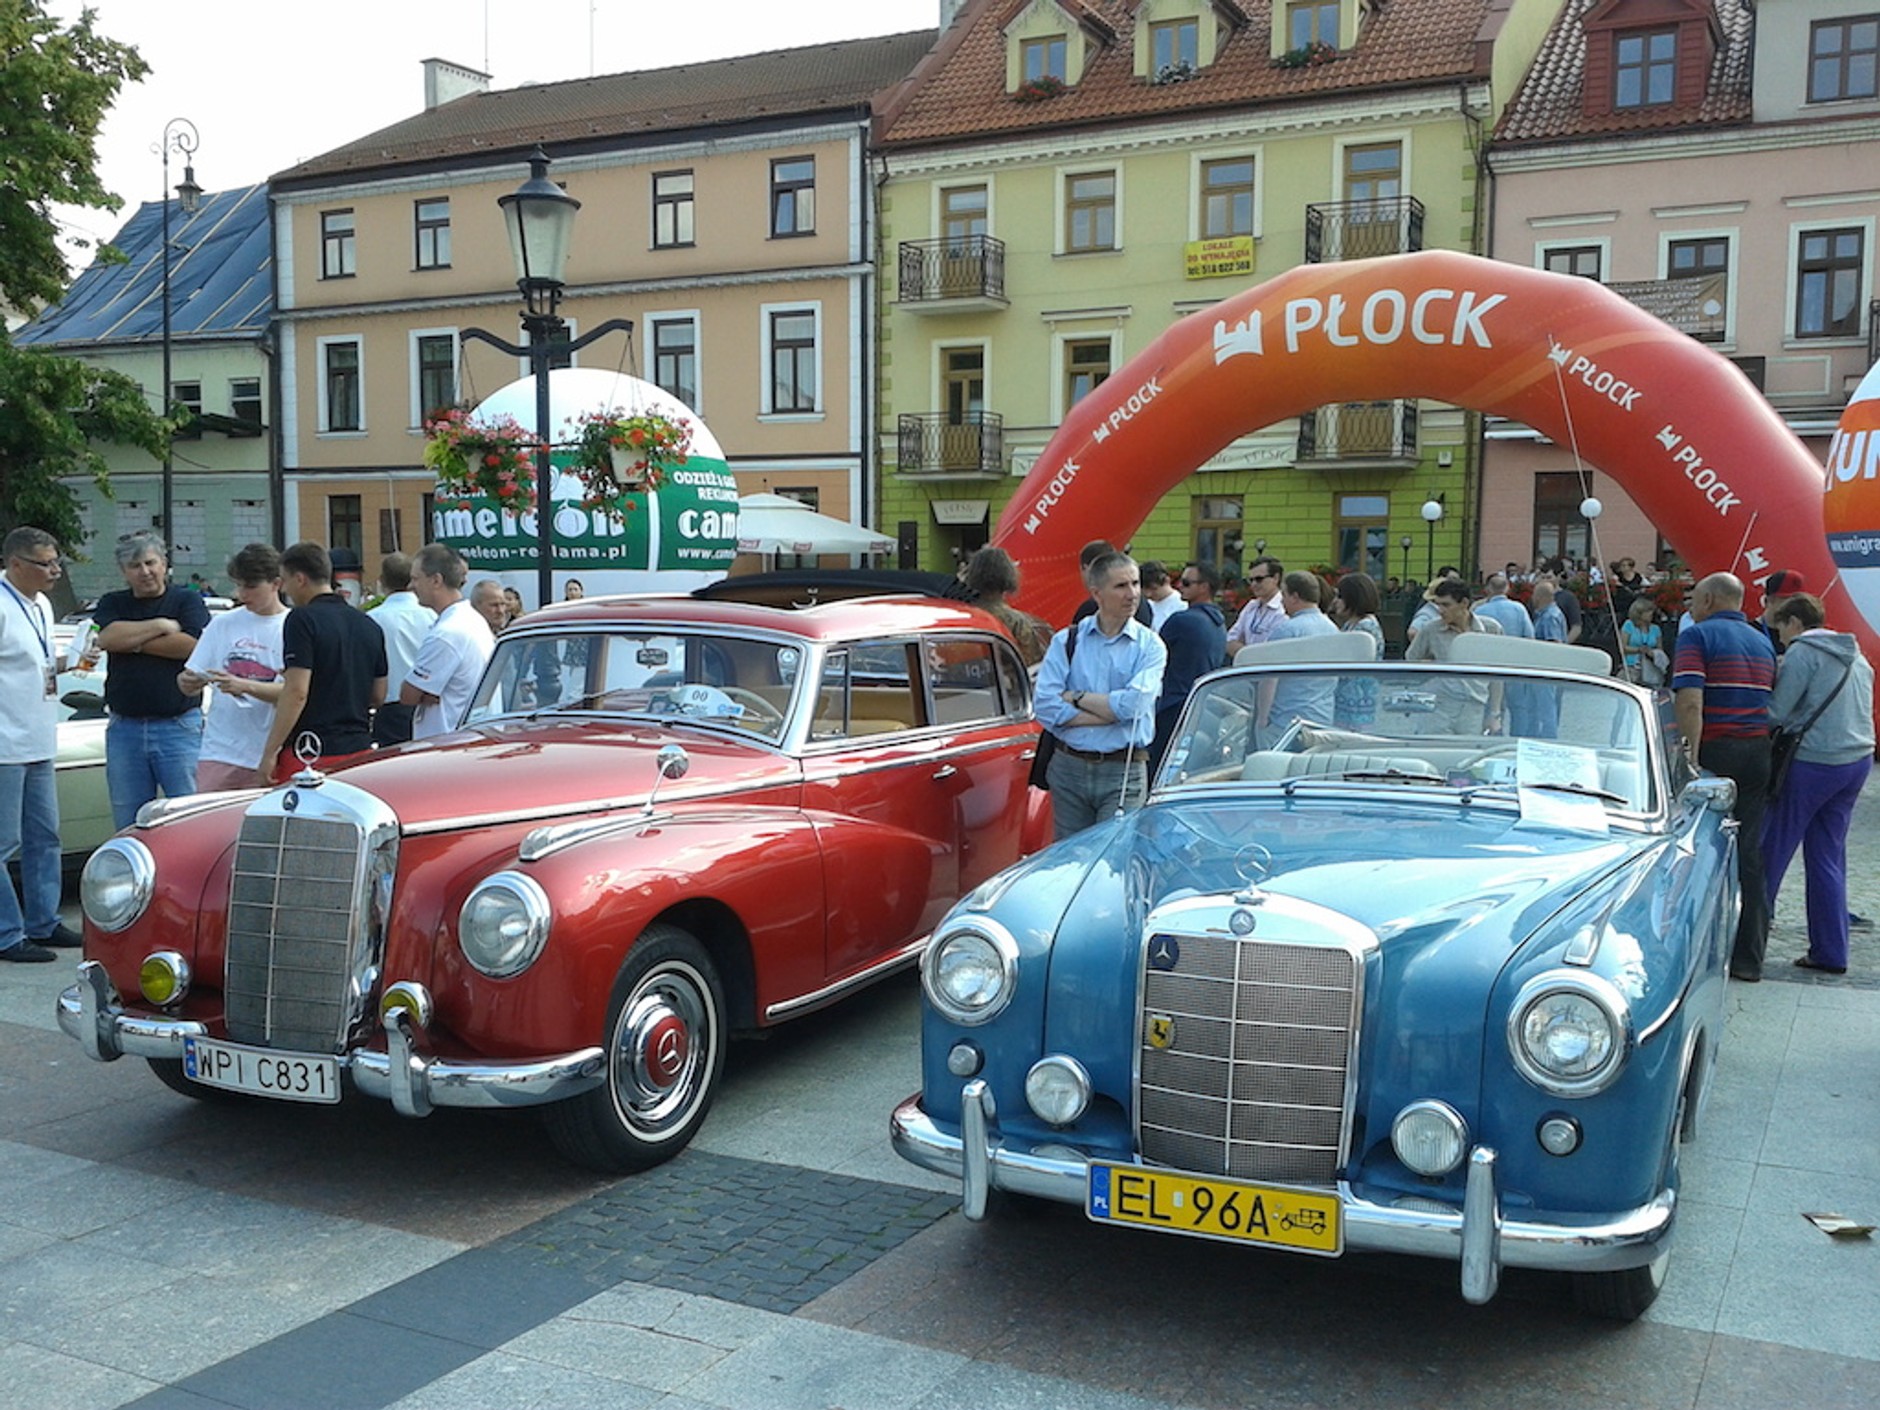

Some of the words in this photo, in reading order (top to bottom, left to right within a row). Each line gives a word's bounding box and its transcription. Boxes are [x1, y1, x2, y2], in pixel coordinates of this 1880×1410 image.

[1285, 289, 1508, 353] PŁOCK
[1109, 376, 1163, 430] PŁOCK
[1568, 356, 1642, 411] PŁOCK
[1036, 457, 1081, 517] PŁOCK
[1673, 445, 1741, 517] PŁOCK
[199, 1046, 243, 1084] WPI
[257, 1057, 326, 1095] C831
[1094, 1196, 1108, 1209] PL
[1118, 1175, 1171, 1220] EL
[1192, 1186, 1270, 1236] 96A
